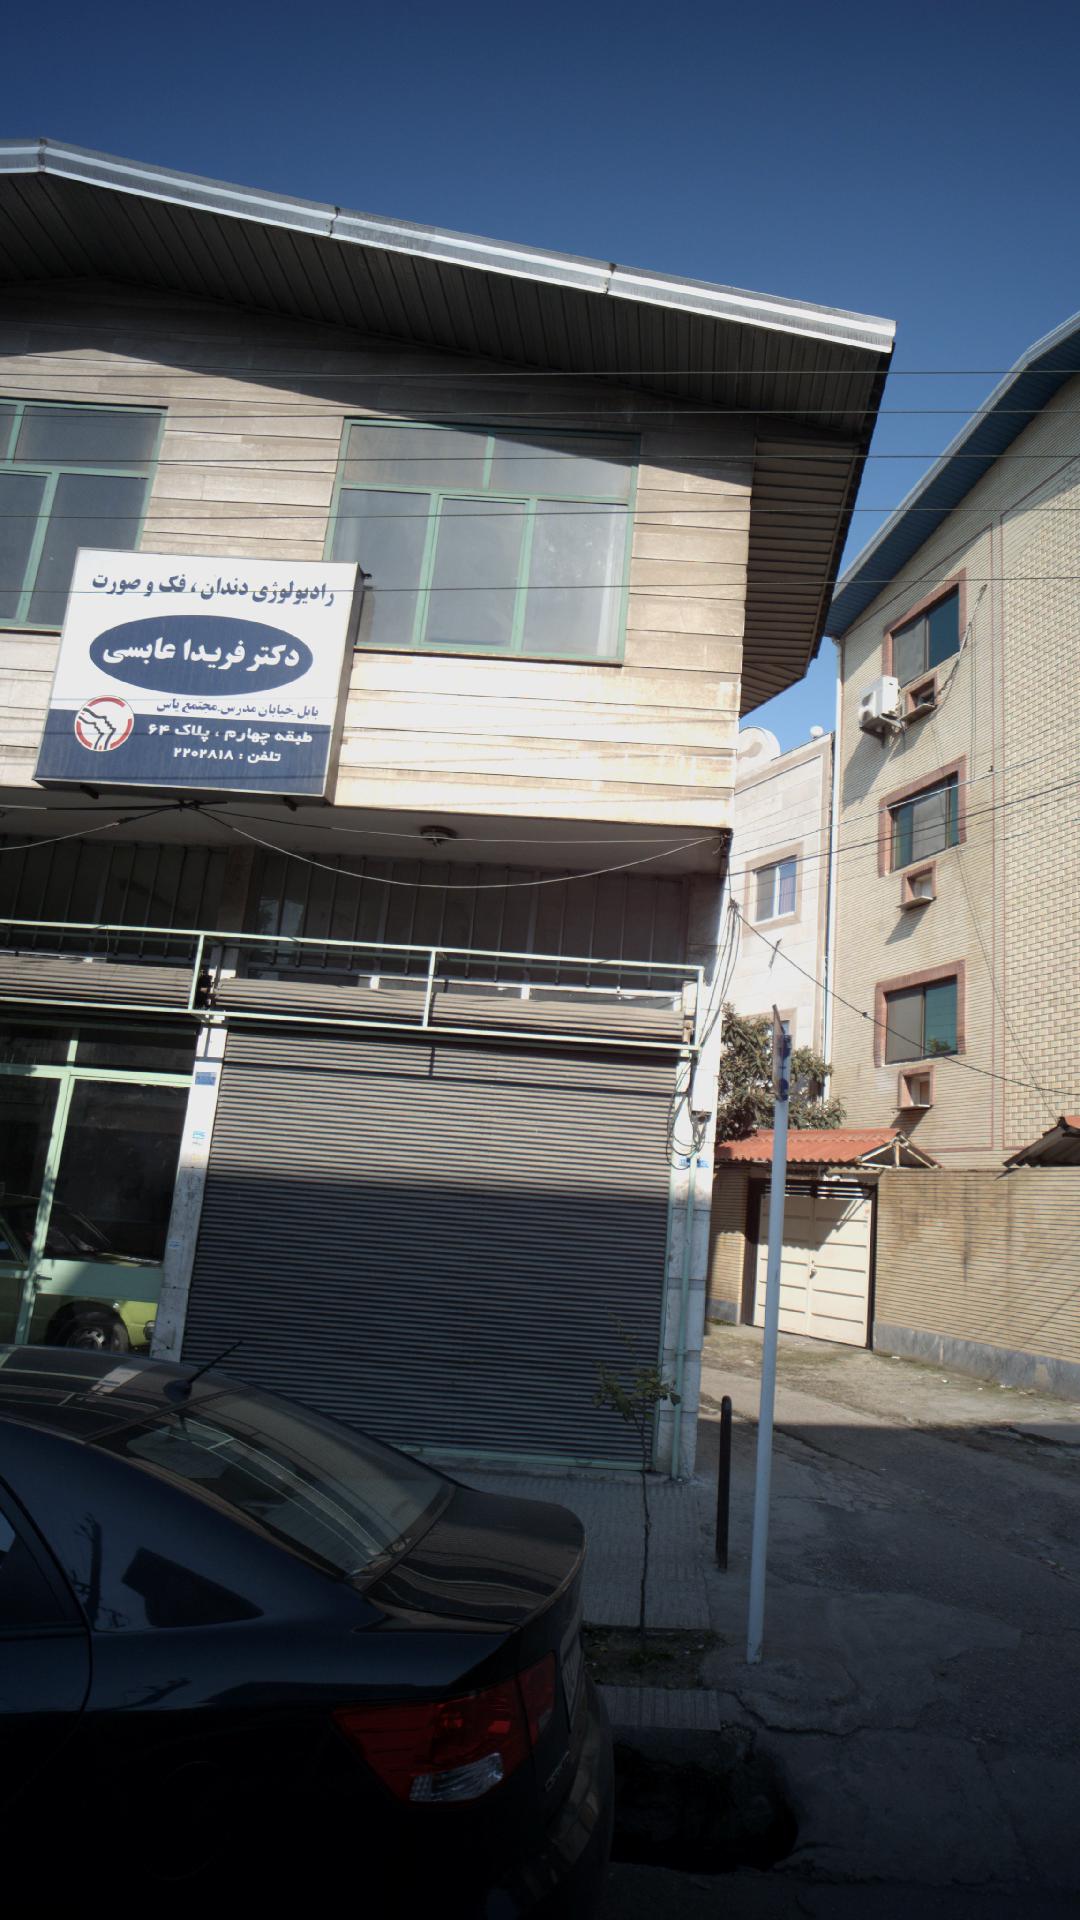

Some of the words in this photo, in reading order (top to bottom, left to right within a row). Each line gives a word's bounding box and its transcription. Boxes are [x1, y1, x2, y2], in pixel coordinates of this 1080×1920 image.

[92, 574, 141, 596] صورت
[144, 581, 154, 597] و
[158, 574, 187, 593] فک
[200, 577, 249, 600] دندان
[252, 580, 335, 606] رادیولوژی
[102, 636, 176, 665] عابسی
[183, 638, 245, 670] فریدا
[246, 643, 300, 672] دکتر
[181, 701, 217, 713] مجتمع
[220, 704, 256, 716] مدرس
[258, 703, 293, 717] خیابان
[297, 705, 319, 721] بابل
[148, 723, 171, 736] ۶۴
[174, 724, 211, 742] پلاک
[224, 727, 271, 746] چهارم
[274, 729, 313, 746] طبقه
[173, 747, 234, 761] ۲۲۰۲۸۱۸
[247, 750, 282, 764] تلفن
